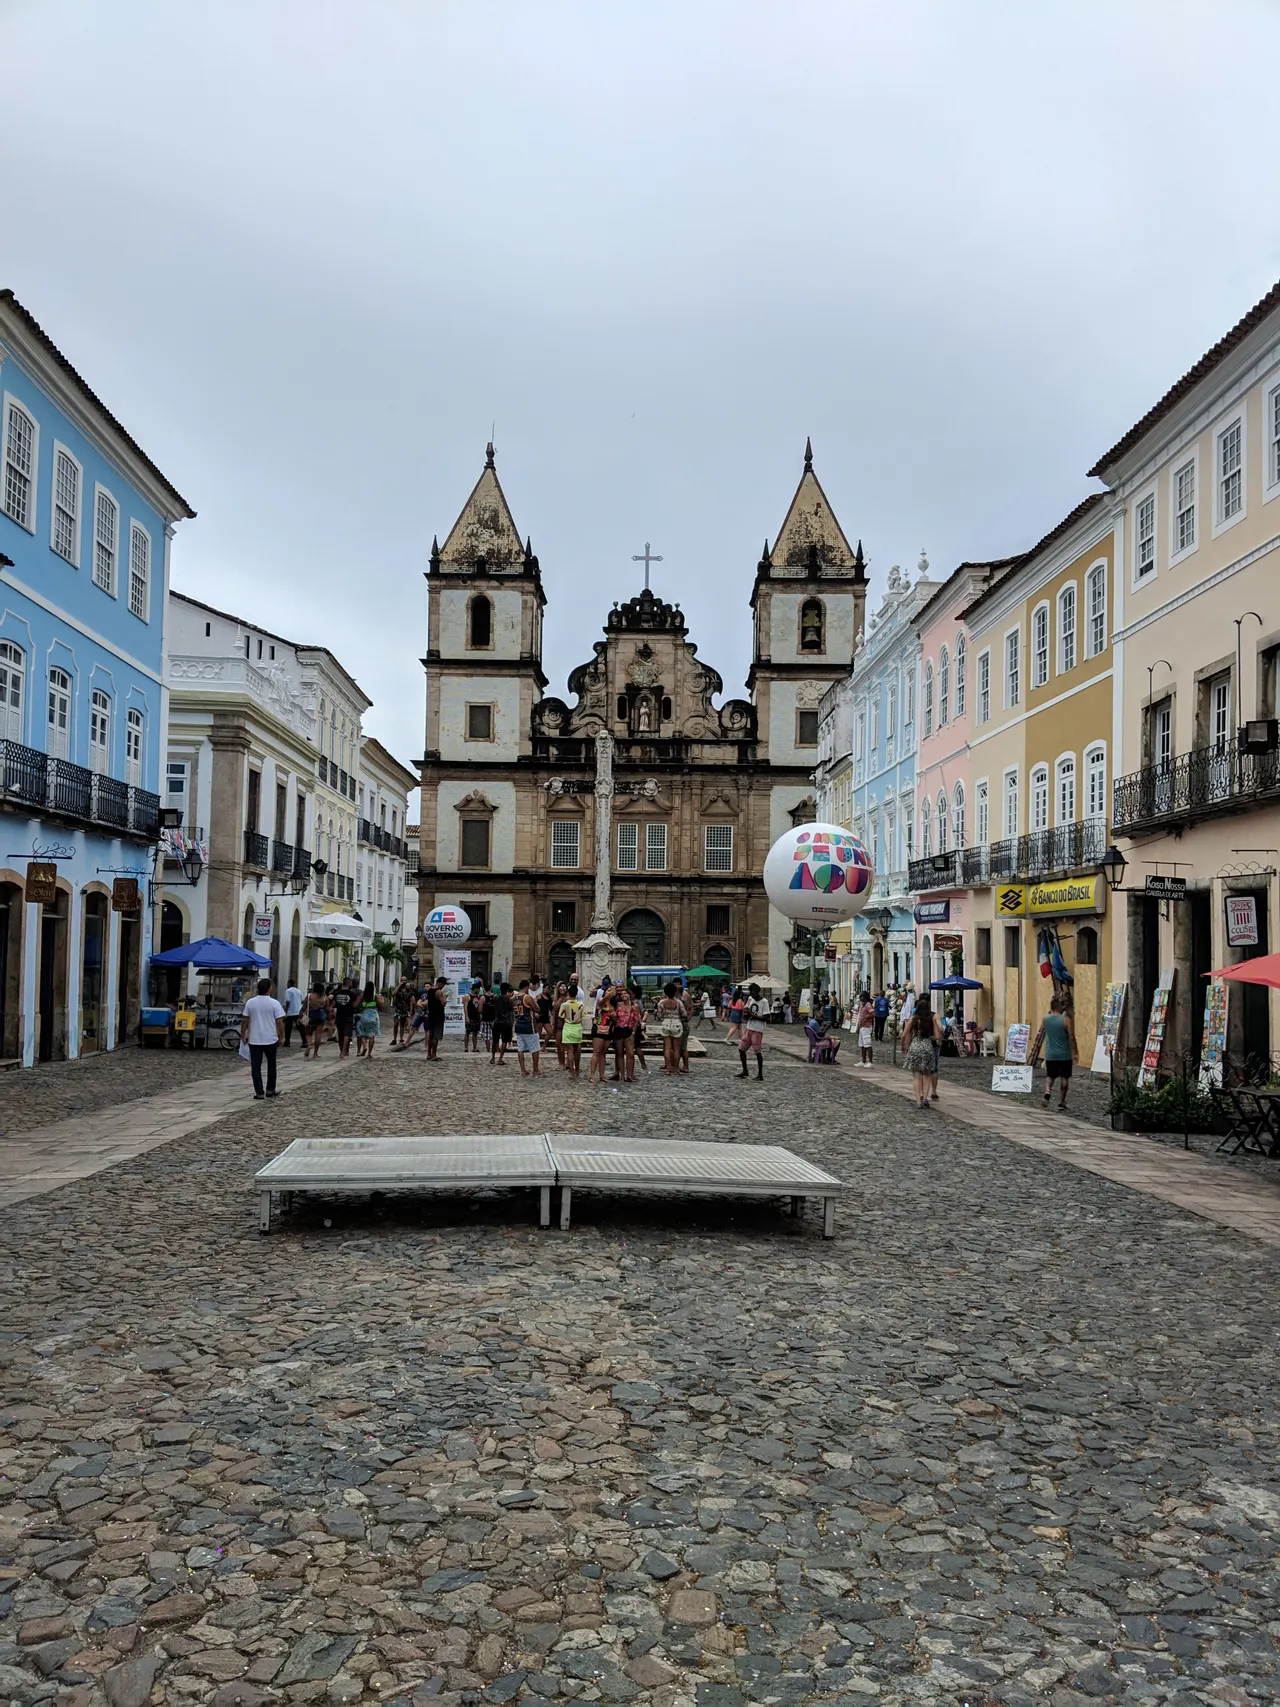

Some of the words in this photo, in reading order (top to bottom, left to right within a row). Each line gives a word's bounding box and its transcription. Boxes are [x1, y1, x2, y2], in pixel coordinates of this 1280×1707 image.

[793, 845, 830, 862] SE
[1038, 889, 1058, 905] BANCO
[1059, 888, 1067, 903] DO
[1067, 884, 1091, 902] BRASIL
[1171, 892, 1185, 900] ARTE
[425, 924, 464, 932] GOVERNO
[434, 931, 464, 939] ESTADO
